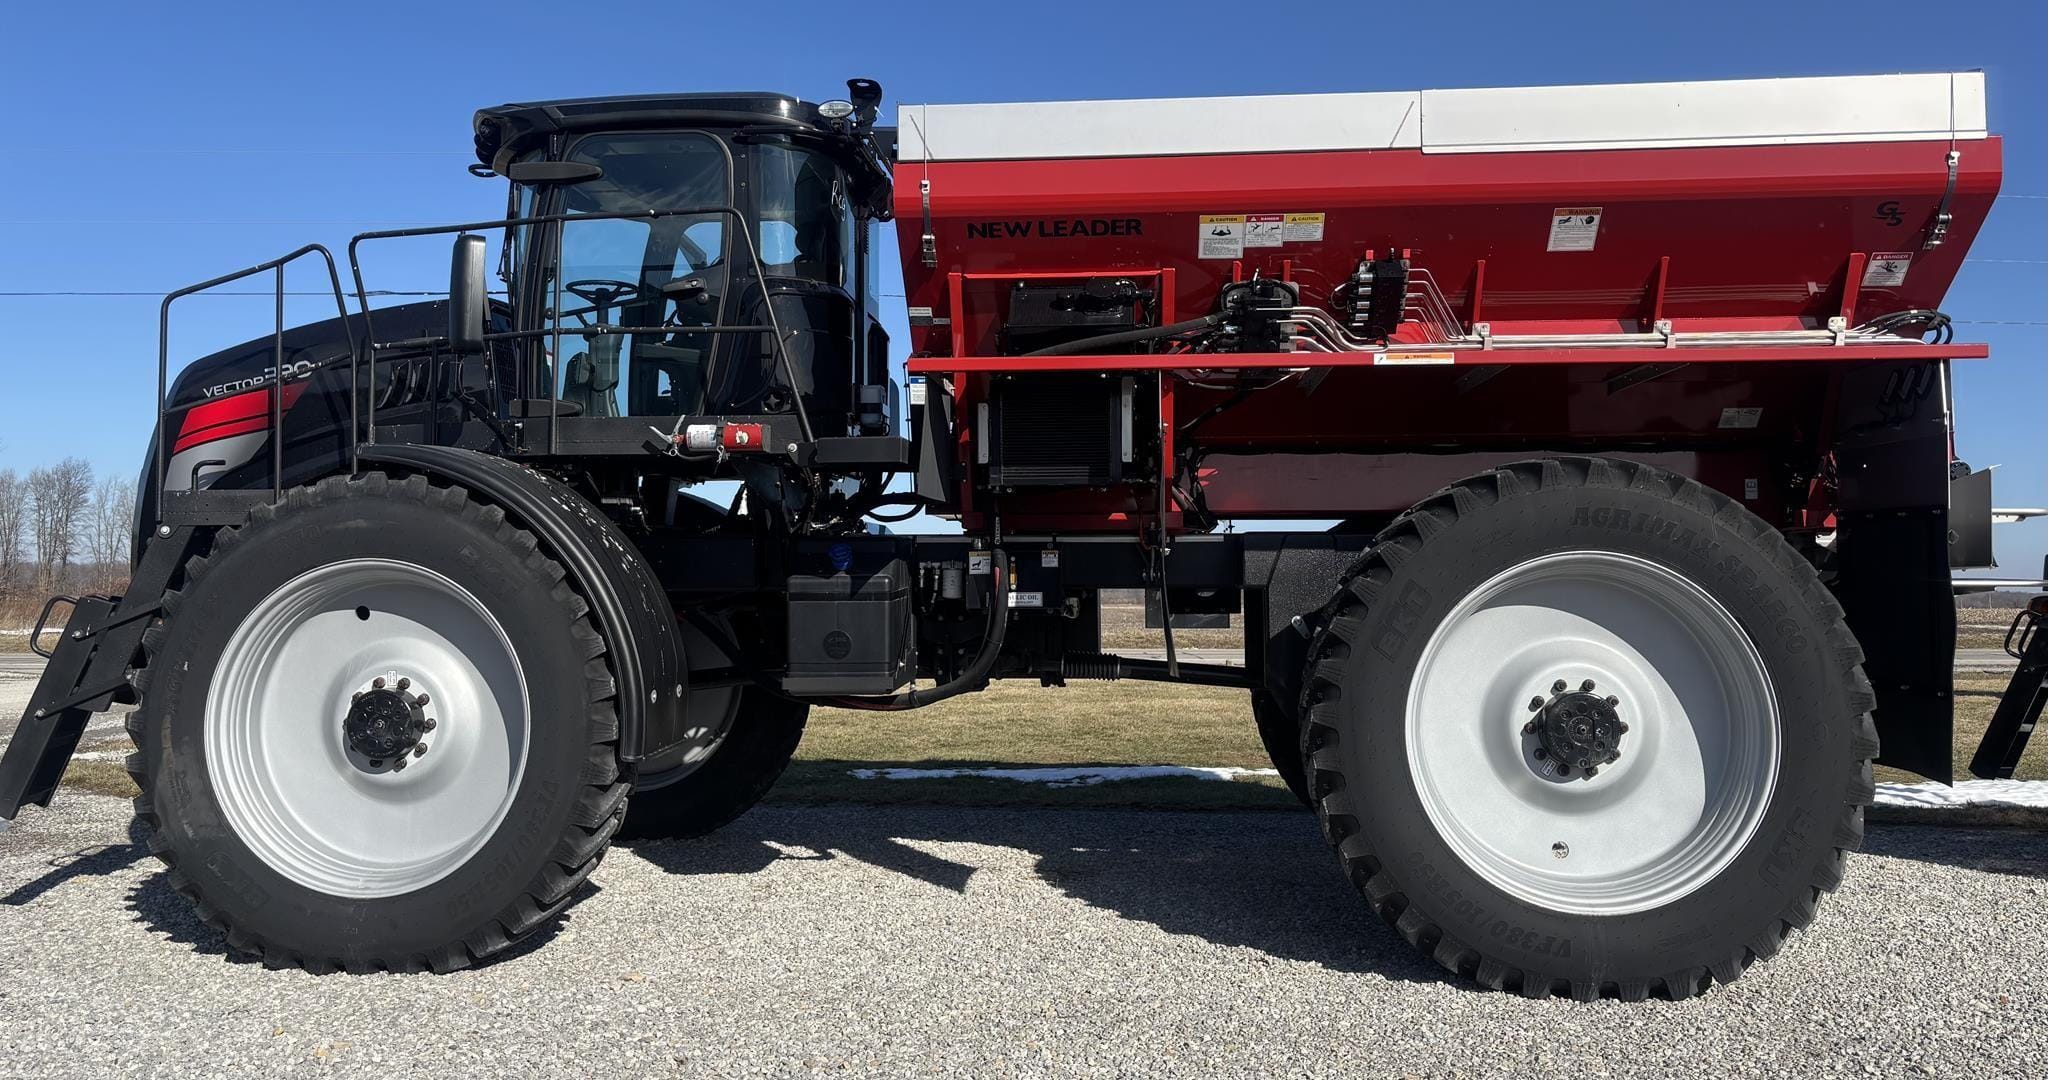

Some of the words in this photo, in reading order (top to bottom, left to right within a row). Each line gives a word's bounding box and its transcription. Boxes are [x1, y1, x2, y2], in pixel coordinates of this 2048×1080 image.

[966, 221, 1033, 239] NEW
[1038, 218, 1143, 238] LEADER
[202, 375, 265, 398] VECTOR
